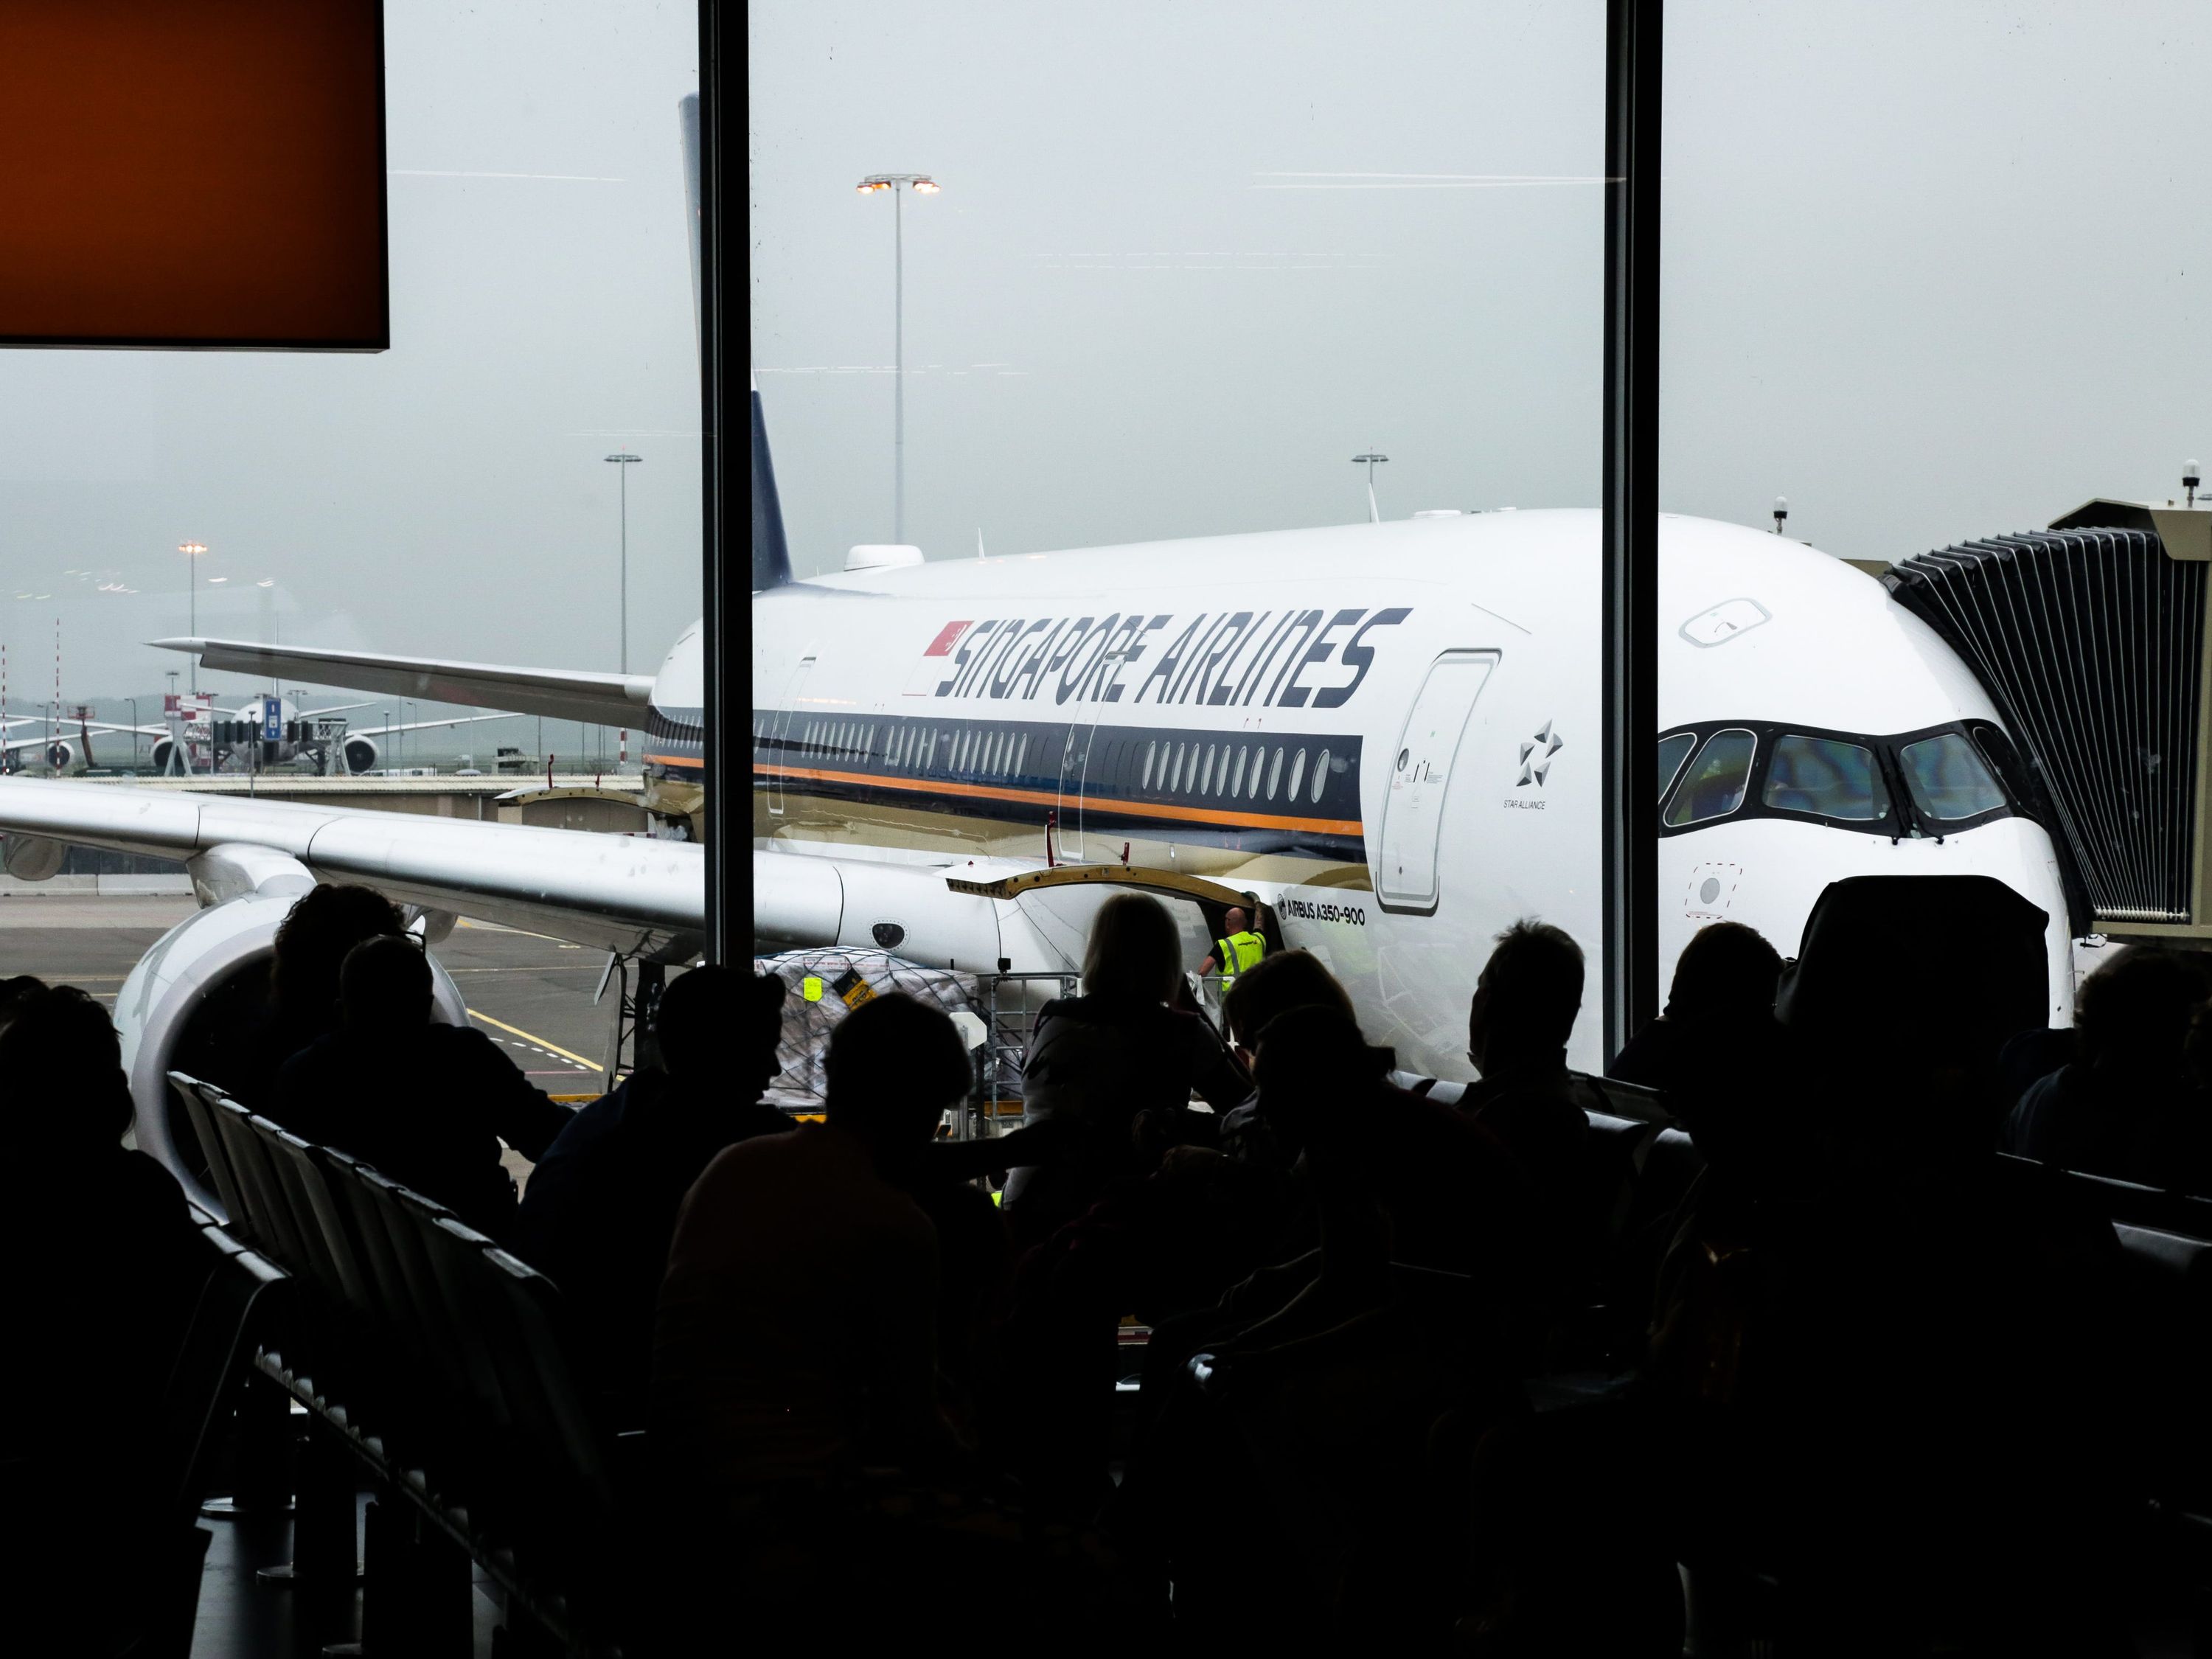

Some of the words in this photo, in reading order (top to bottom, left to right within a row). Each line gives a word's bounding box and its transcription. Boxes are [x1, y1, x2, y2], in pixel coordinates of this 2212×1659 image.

[935, 613, 1174, 706] SINGAPORE
[1134, 608, 1414, 709] AIRLINES
[1503, 799, 1518, 809] STAR
[1518, 801, 1546, 810] ALLIANCE
[1287, 900, 1315, 919] AIRBUS
[1316, 903, 1366, 926] A350-900
